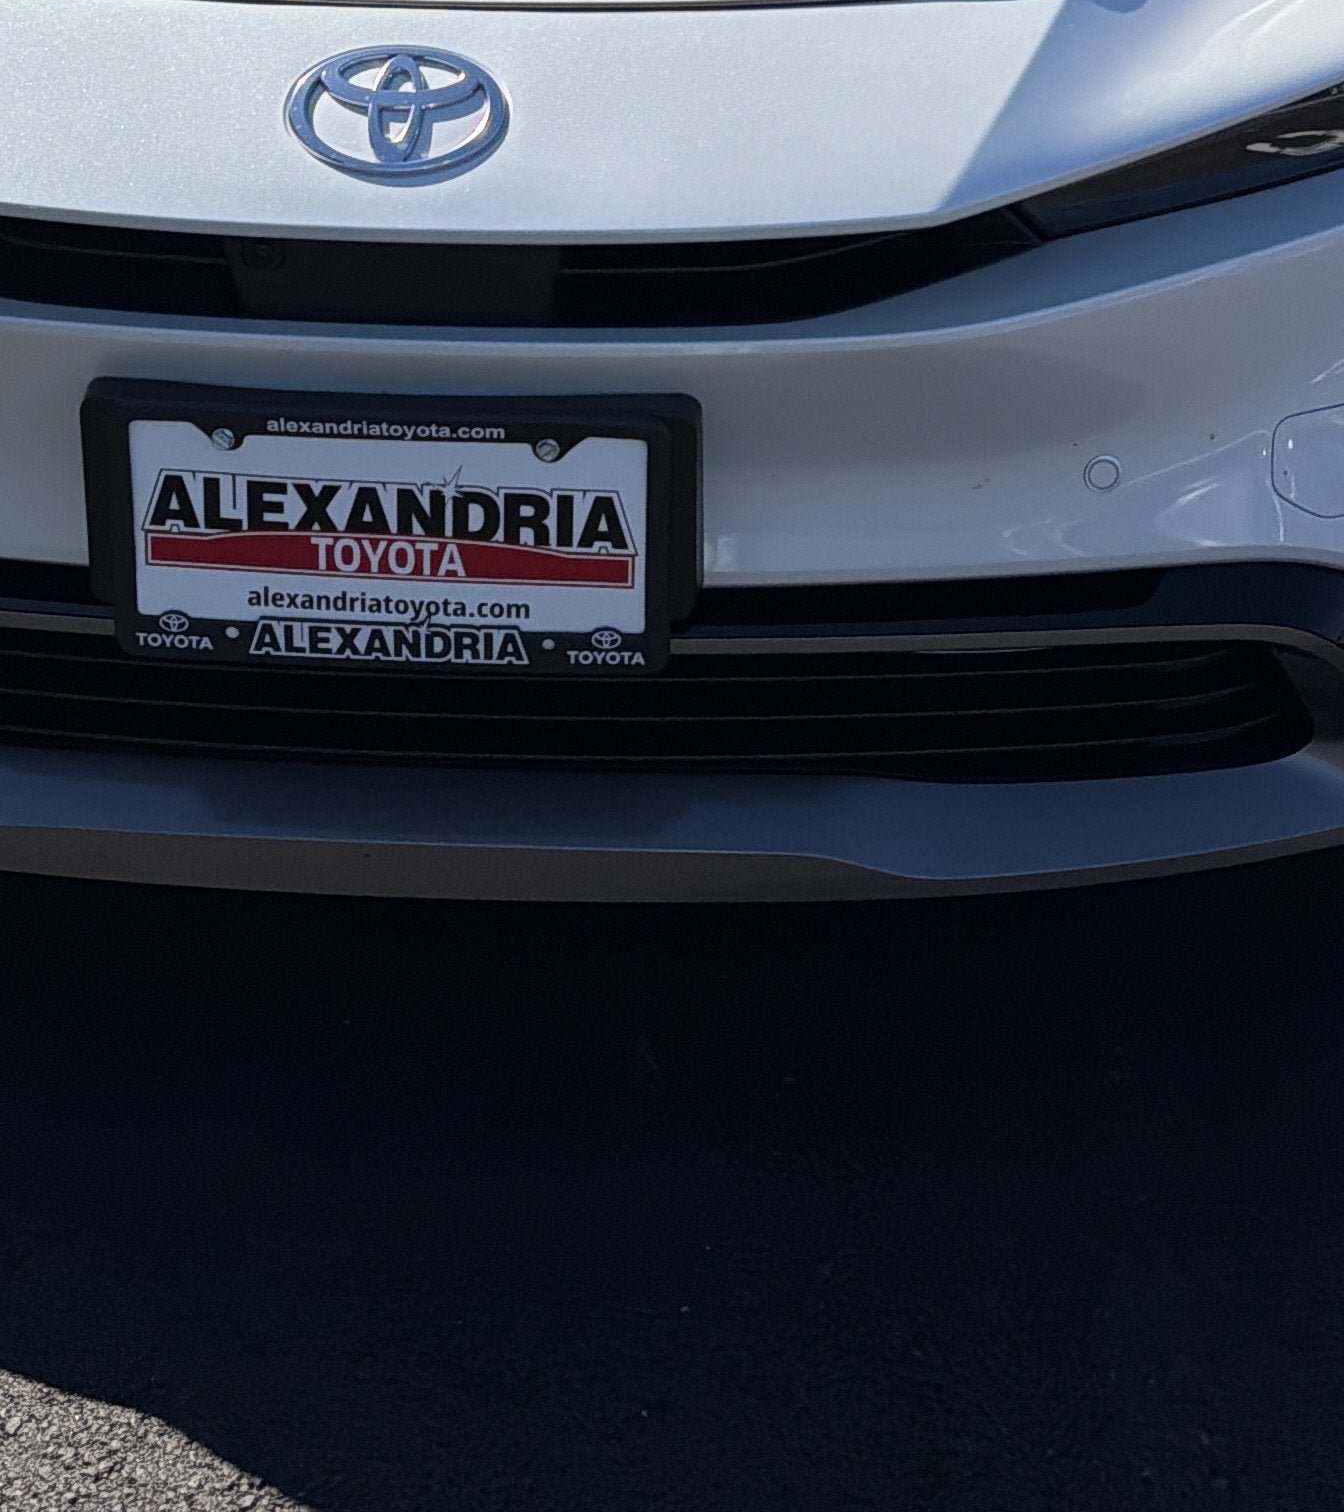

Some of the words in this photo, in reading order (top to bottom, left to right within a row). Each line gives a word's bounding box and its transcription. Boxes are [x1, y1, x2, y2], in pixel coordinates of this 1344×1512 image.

[266, 417, 507, 441] alexandriatoyota.com
[143, 468, 639, 556] ALEXANDRIA
[311, 535, 467, 577] TOYOTA
[247, 586, 531, 621] alexandriatoyota.com
[135, 631, 214, 650] TOYOTA
[249, 617, 530, 665] ALEXANDRIA
[566, 649, 646, 666] TOYOTA
